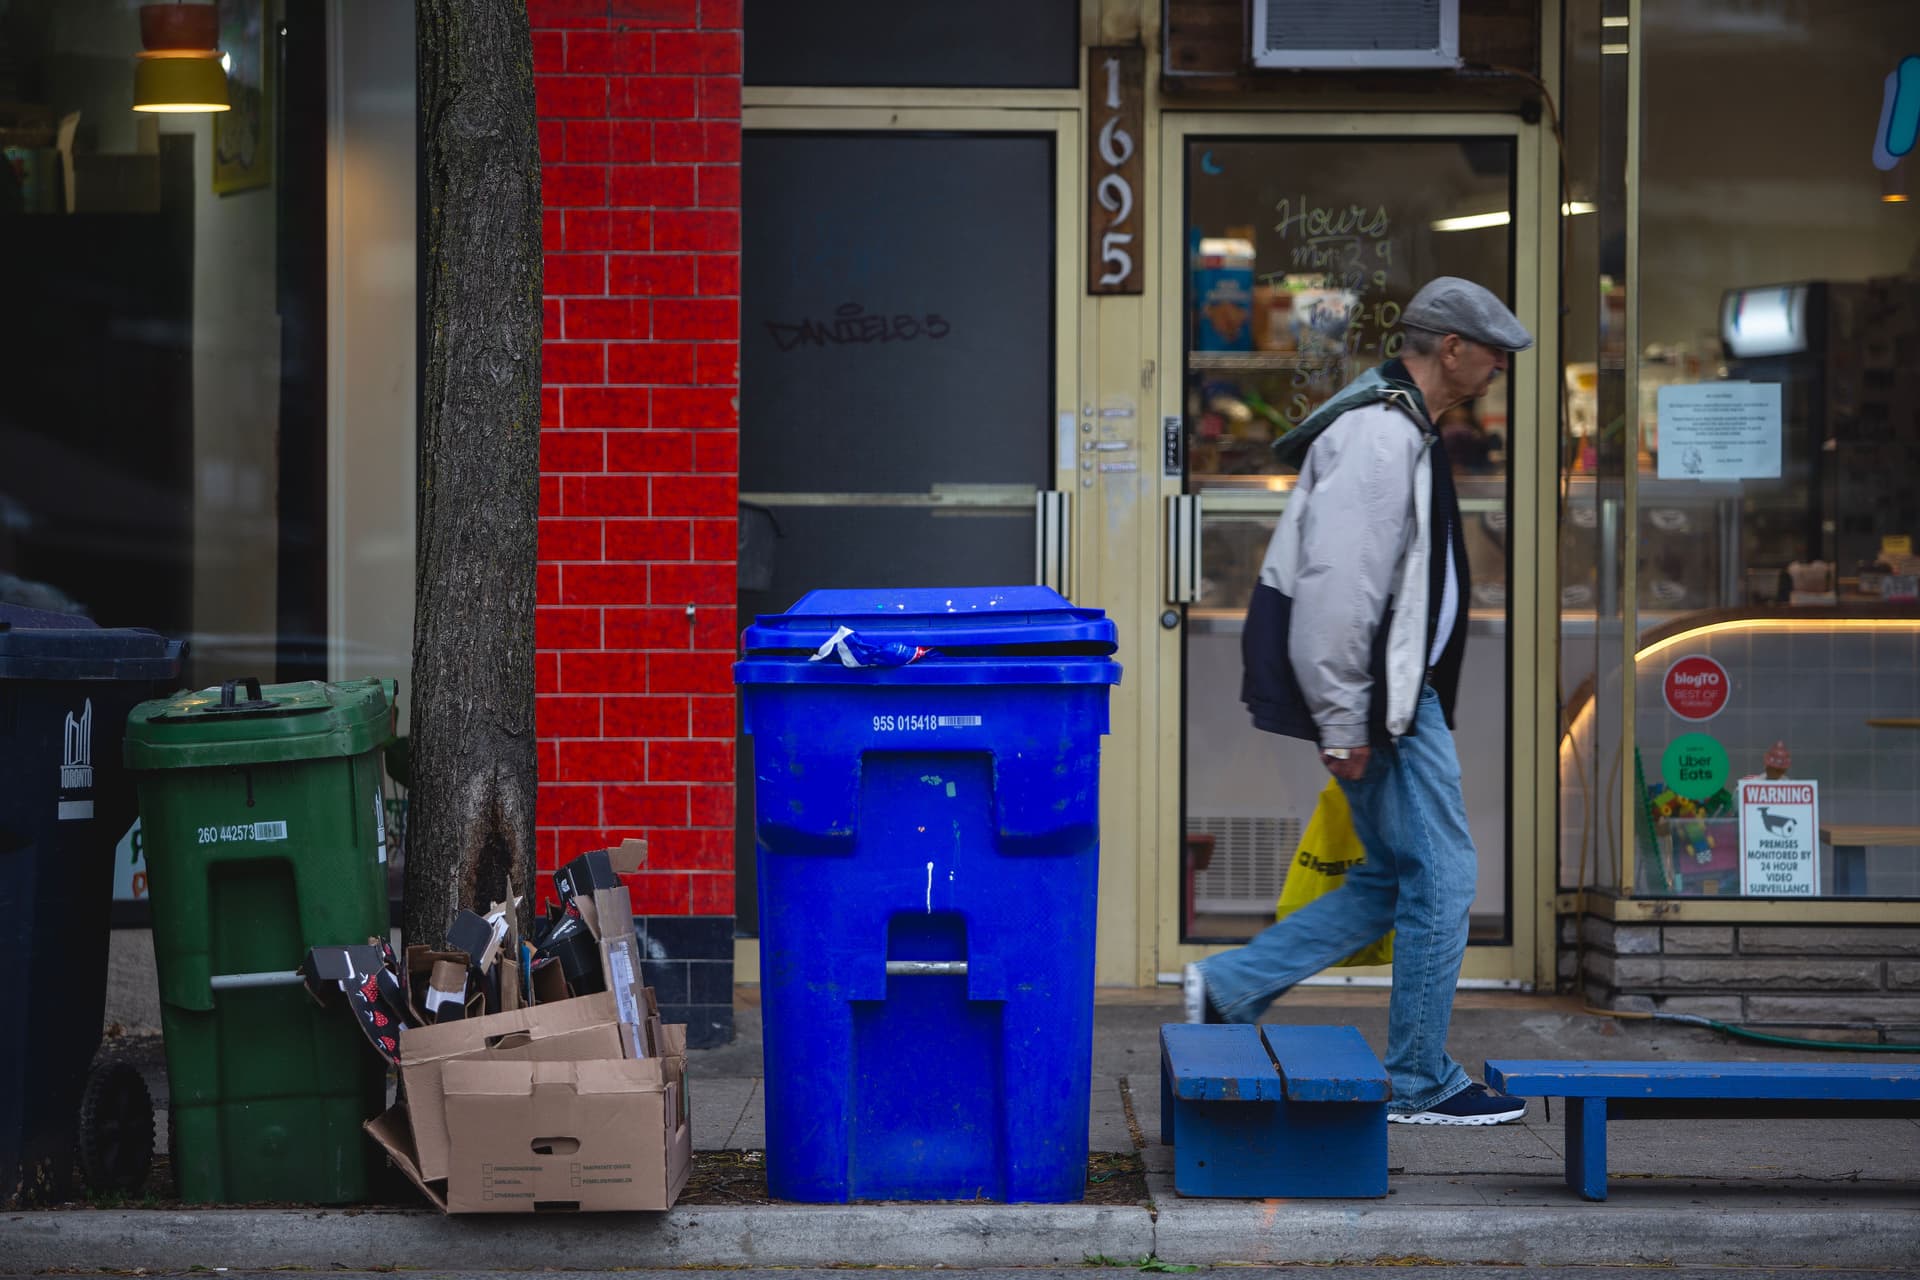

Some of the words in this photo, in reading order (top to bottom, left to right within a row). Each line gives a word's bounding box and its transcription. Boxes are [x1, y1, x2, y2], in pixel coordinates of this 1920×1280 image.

[1097, 57, 1134, 285] 1695
[1274, 195, 1391, 239] Hours
[1674, 672, 1719, 687] blogTO
[1674, 689, 1700, 699] BEST
[1703, 689, 1719, 699] OF
[873, 715, 894, 731] 95S
[897, 715, 937, 731] 015418
[1678, 755, 1712, 767] Uber
[60, 765, 93, 788] TORONTO
[1679, 769, 1713, 781] Eats
[1746, 786, 1811, 802] WARNING
[220, 824, 255, 841] 442573
[1759, 840, 1798, 849] PREMISES
[1748, 851, 1798, 860] MONITORED
[1801, 851, 1811, 860] BY
[1761, 862, 1771, 871] 24
[1773, 862, 1798, 871] HOUR
[1766, 872, 1793, 881] VIDEO
[1750, 884, 1809, 893] SURVEILLANCE
